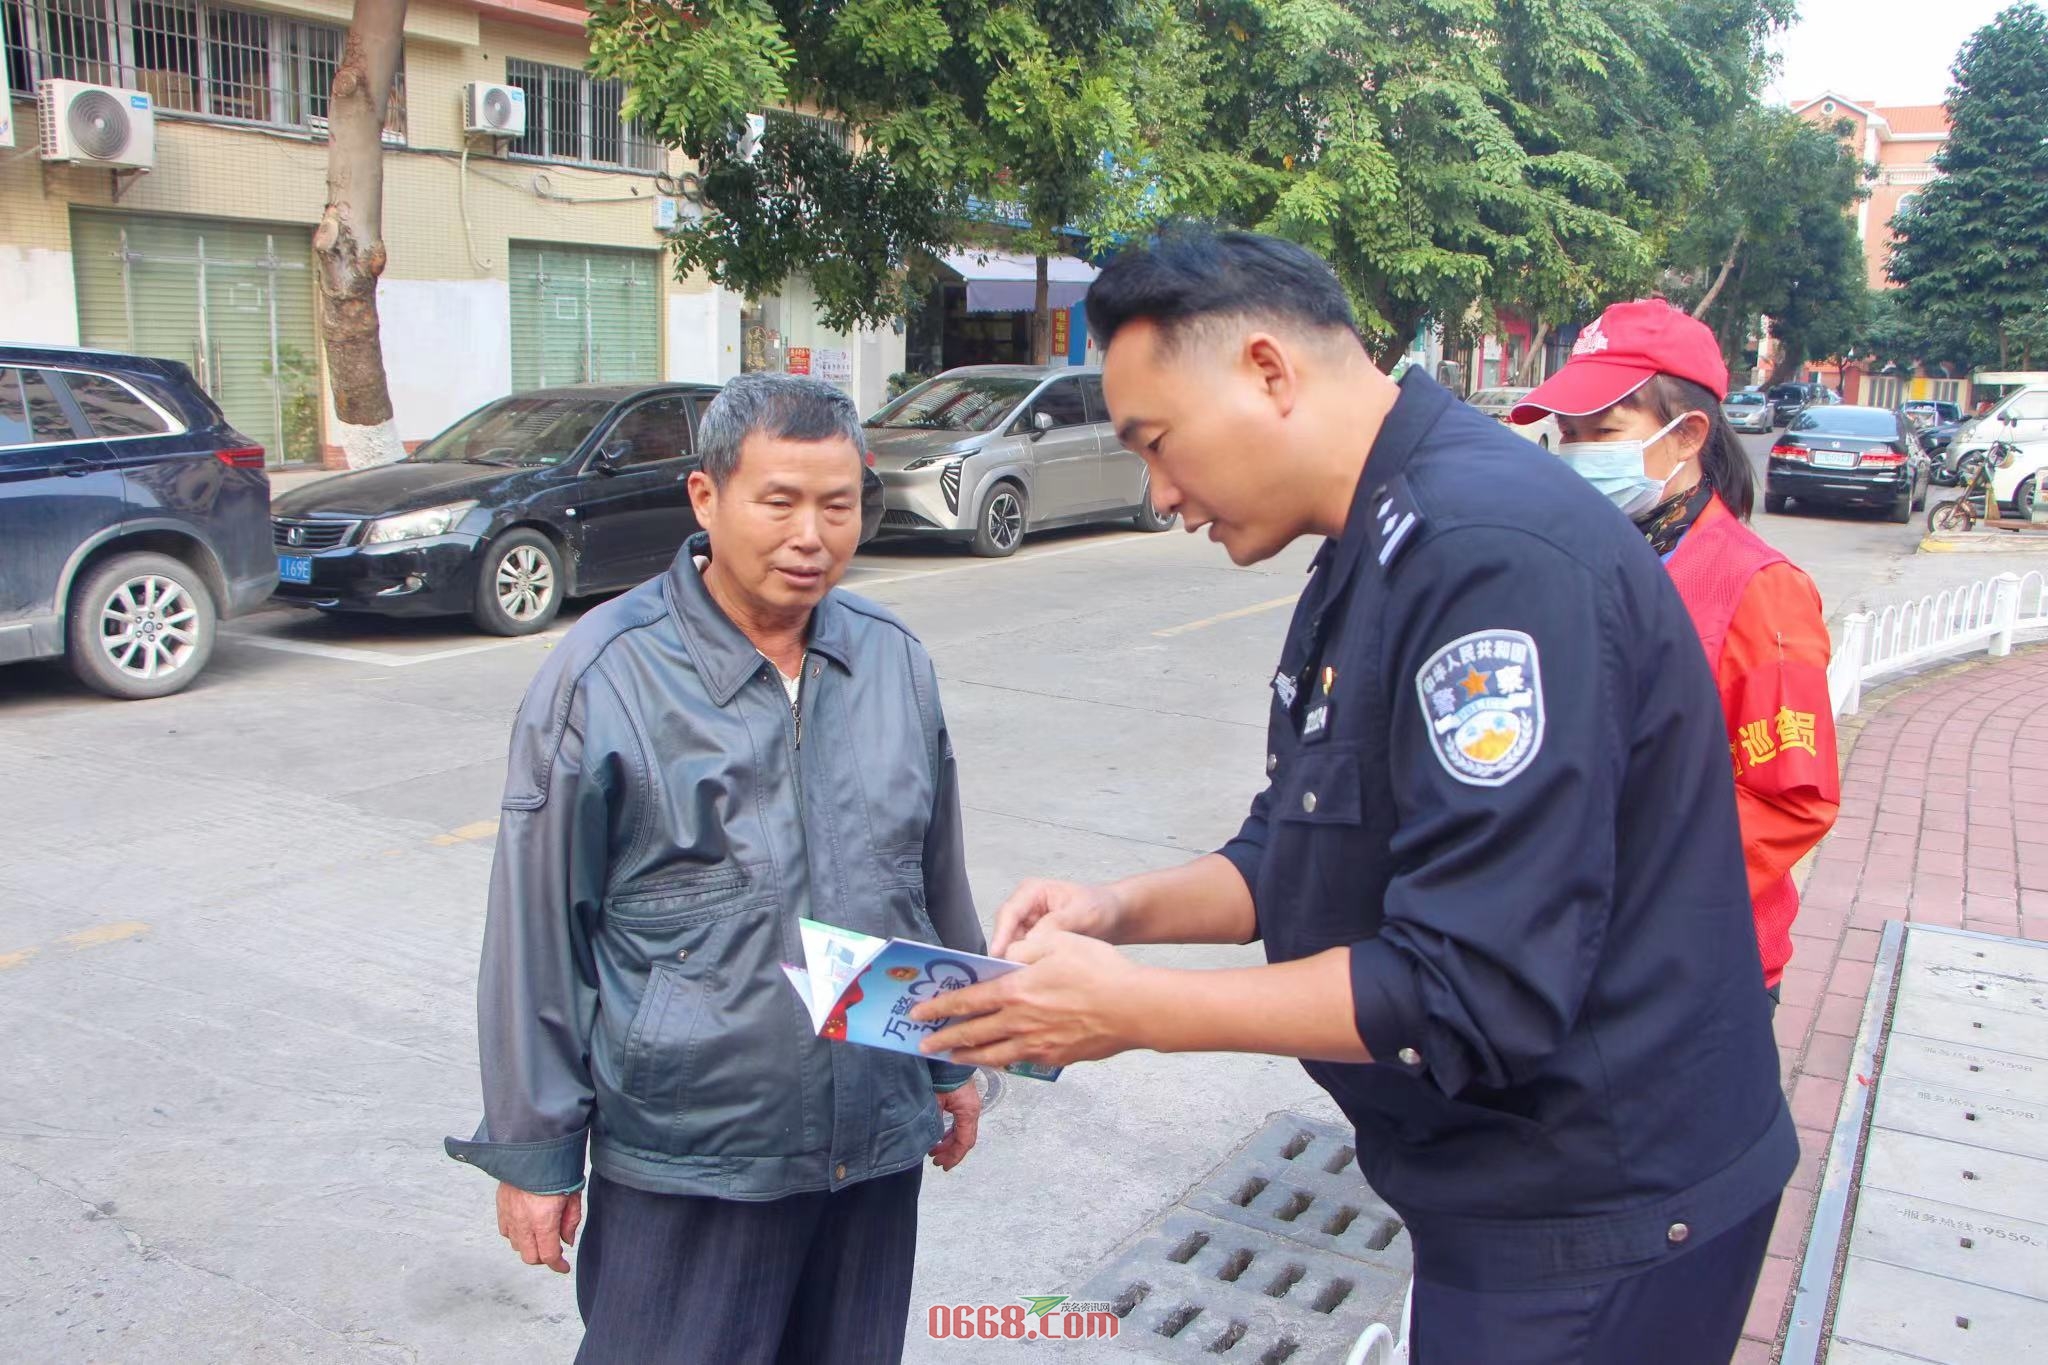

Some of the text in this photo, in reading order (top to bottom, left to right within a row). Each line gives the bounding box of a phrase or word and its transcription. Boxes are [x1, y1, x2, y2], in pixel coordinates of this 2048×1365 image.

[1423, 639, 1528, 694] 中华人民共和国
[1729, 705, 1817, 777] 巡查员
